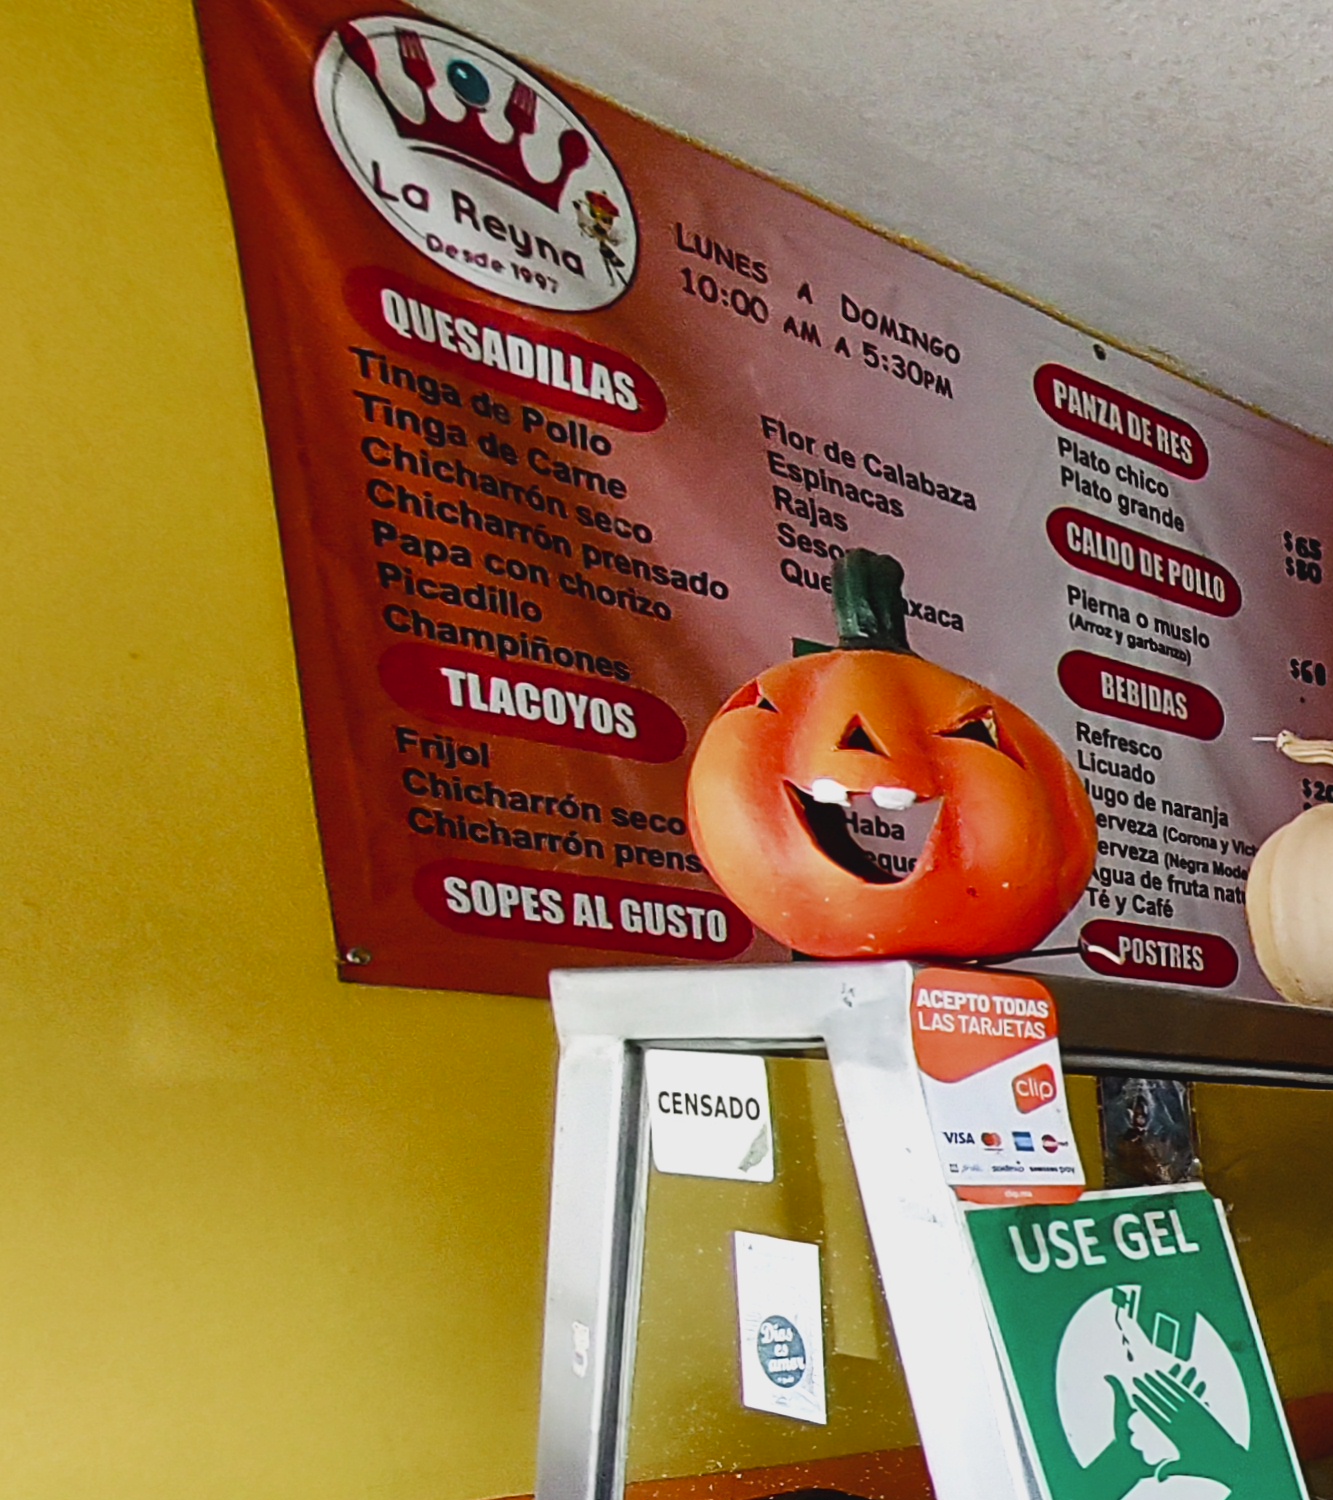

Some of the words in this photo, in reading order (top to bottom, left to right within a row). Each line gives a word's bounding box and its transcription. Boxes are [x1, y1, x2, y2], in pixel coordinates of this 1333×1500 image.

[371, 160, 430, 213] La
[451, 189, 586, 278] Reyna
[425, 233, 506, 273] Desde
[511, 262, 561, 294] 1997
[675, 221, 769, 285] LUNES
[797, 283, 814, 304] A
[841, 293, 962, 365] DOMINGO
[380, 288, 640, 412] QUESADILLAS
[680, 267, 770, 325] 10:00
[783, 316, 822, 348] AM
[834, 336, 852, 359] A
[861, 341, 955, 400] 5:30PM
[349, 346, 463, 408] Tinga
[471, 389, 511, 426] de
[522, 407, 612, 457] Pollo
[1053, 378, 1124, 434] PANZA
[1127, 410, 1153, 447] DE
[1156, 423, 1194, 465] RES
[354, 390, 468, 449] Tinga
[478, 432, 519, 465] de
[527, 448, 628, 499] Carne
[760, 414, 816, 456] Flor
[824, 441, 856, 469] de
[863, 453, 978, 511] Calabaza
[1057, 436, 1111, 475] Plato
[1116, 464, 1170, 498] chico
[360, 436, 569, 519] Chicharrón
[575, 504, 654, 546] seco
[766, 450, 905, 518] Espinacas
[772, 485, 849, 532] Rajas
[1060, 465, 1112, 504] Plato
[1118, 493, 1185, 533] grande
[365, 478, 572, 558] Chicharrón
[581, 543, 730, 602] prensado
[371, 519, 472, 570] Papa
[484, 551, 550, 588] con
[558, 569, 673, 622] chorizo
[776, 522, 846, 561] Seso
[1066, 521, 1136, 571] CALDO
[1138, 547, 1164, 583] DE
[1168, 558, 1225, 603] POLLO
[376, 561, 544, 624] Picadillo
[780, 558, 833, 595] Que
[901, 598, 965, 632] axaca
[1067, 584, 1130, 625] Pierna
[1135, 612, 1149, 629] o
[1154, 617, 1210, 649] muslo
[382, 604, 632, 682] Champiñones
[1069, 611, 1113, 639] (Arroz
[1115, 630, 1124, 645] y
[1127, 633, 1192, 667] garbanzo)
[440, 667, 638, 741] TLACOYOS
[1100, 671, 1189, 721] BEBIDAS
[395, 726, 490, 770] Frijol
[1076, 721, 1163, 761] Refresco
[1077, 749, 1156, 785] Licuado
[402, 768, 603, 823] Chicharrón
[611, 805, 687, 836] seco
[1095, 811, 1158, 838] erveza
[1162, 825, 1217, 850] (Corona
[1220, 840, 1229, 855] y
[1134, 791, 1157, 811] de
[1161, 799, 1229, 829] naranja
[407, 806, 605, 860] Chicharrón
[613, 841, 704, 874] prens
[1097, 839, 1159, 865] erveza
[1164, 852, 1209, 875] (Negra
[1212, 860, 1248, 881] Mode
[442, 876, 565, 926] SOPES
[572, 893, 614, 932] AL
[620, 899, 728, 943] GUSTO
[1085, 886, 1110, 908] Té
[1114, 895, 1127, 916] y
[1132, 894, 1174, 918] Café
[1140, 870, 1162, 891] de
[1167, 874, 1210, 899] fruta
[1118, 935, 1204, 972] POSTRES
[915, 988, 990, 1014] ACEPTO
[992, 994, 1049, 1018] TODAS
[917, 1011, 955, 1033] LAS
[960, 1014, 1046, 1040] TARJETAS
[657, 1090, 761, 1121] CENSADO
[1015, 1077, 1054, 1101] clip
[942, 1131, 976, 1145] VISA
[1008, 1217, 1107, 1274] USE
[1112, 1208, 1200, 1261] GEL
